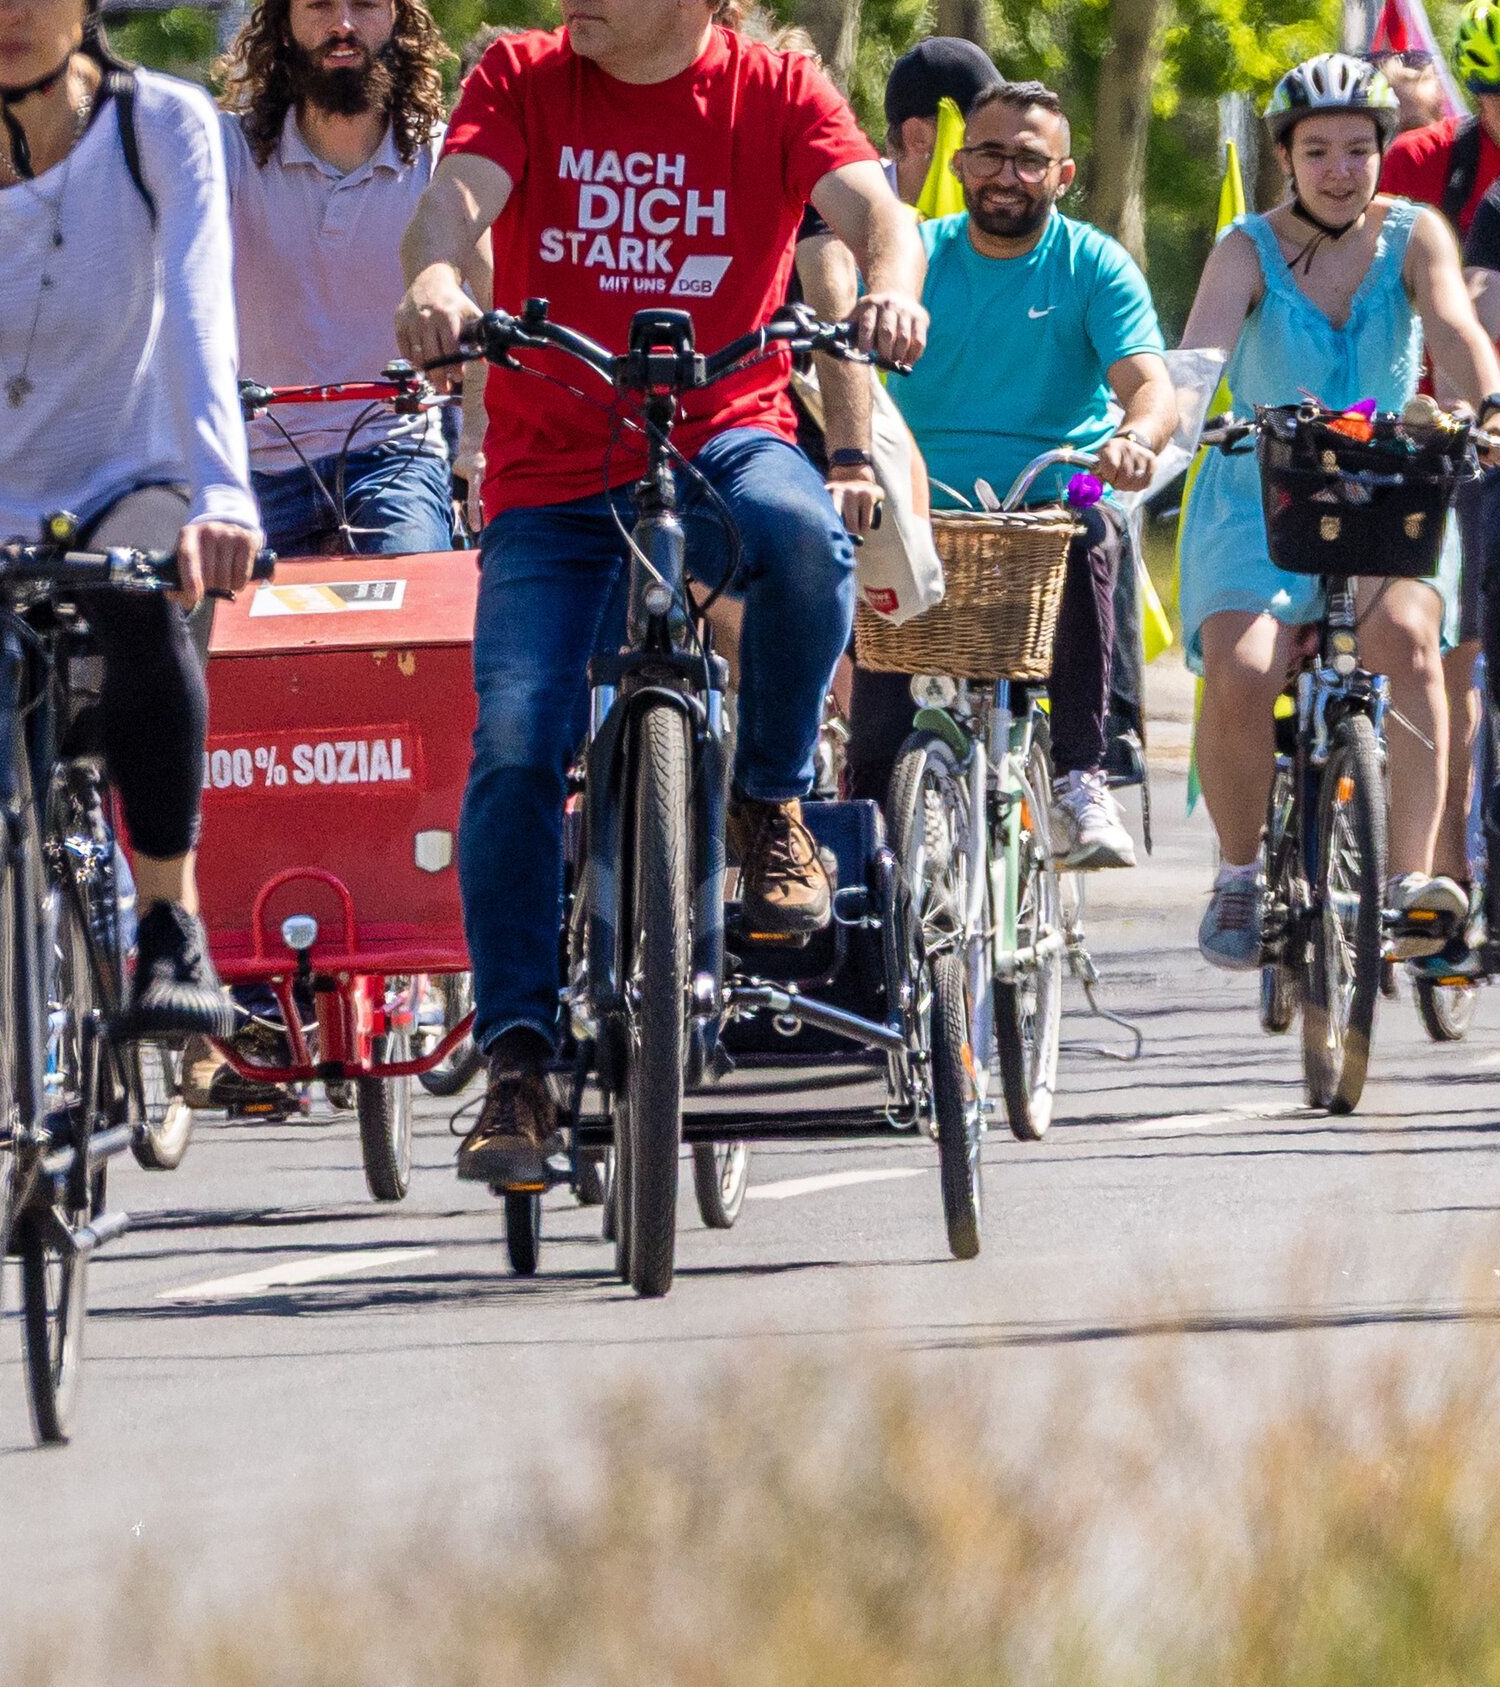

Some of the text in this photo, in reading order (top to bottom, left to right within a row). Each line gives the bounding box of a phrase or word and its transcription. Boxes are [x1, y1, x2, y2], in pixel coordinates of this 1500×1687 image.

[558, 146, 686, 186] MACH
[578, 184, 726, 236] DICH
[539, 227, 674, 273] STARK
[600, 275, 713, 294] MIT UNS DGB
[201, 738, 411, 789] 100% SOZIAL
